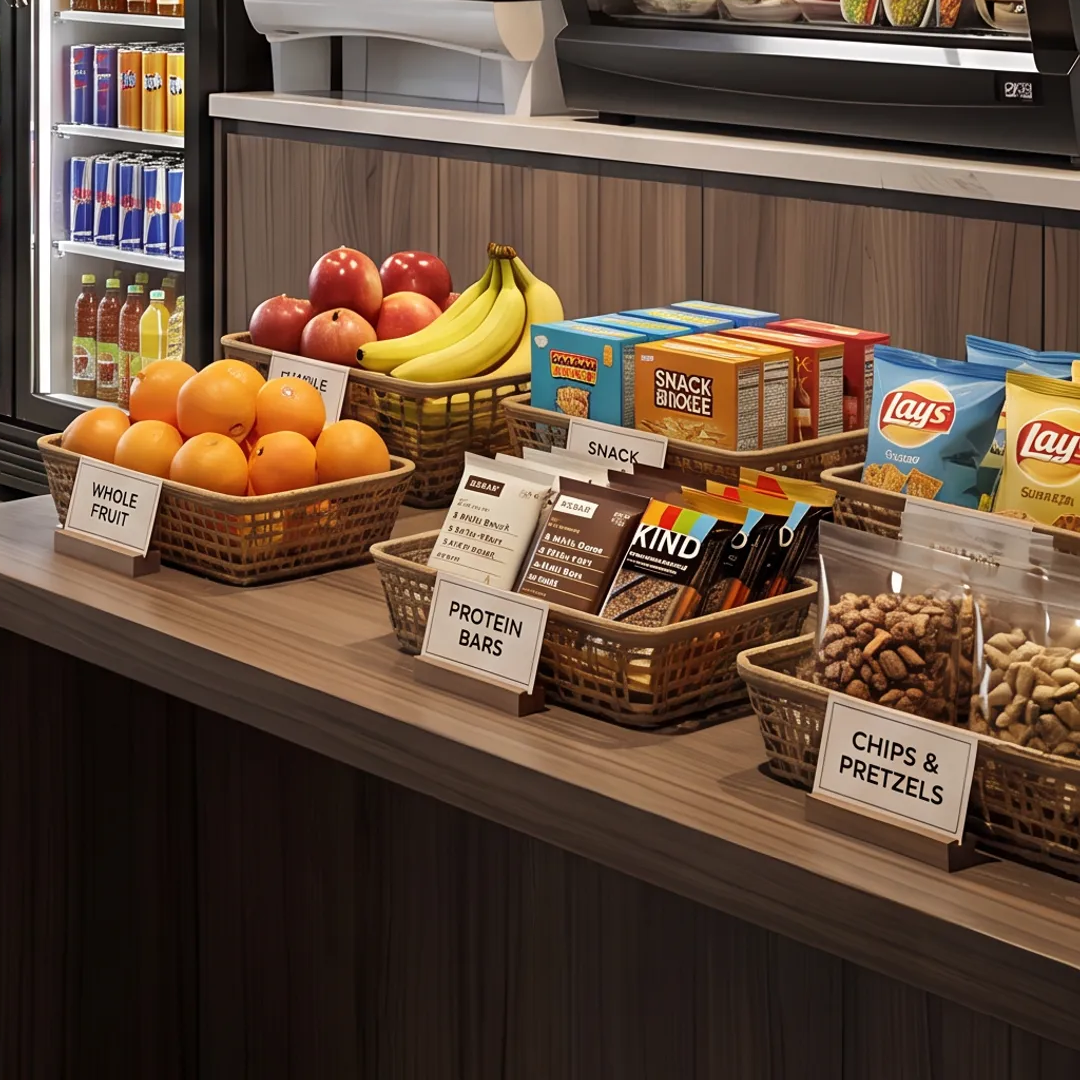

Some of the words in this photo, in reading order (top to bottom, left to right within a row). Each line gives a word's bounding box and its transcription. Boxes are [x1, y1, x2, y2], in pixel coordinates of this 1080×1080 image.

[655, 370, 712, 397] SNACK
[587, 441, 640, 464] SNACK
[92, 481, 139, 509] WHOLE
[90, 503, 130, 527] FRUIT
[631, 523, 701, 560] KIND
[448, 600, 523, 638] PROTEIN
[458, 628, 504, 657] BARS
[851, 730, 917, 767] CHIPS
[922, 752, 939, 775] &
[839, 754, 944, 805] PRETZELS
